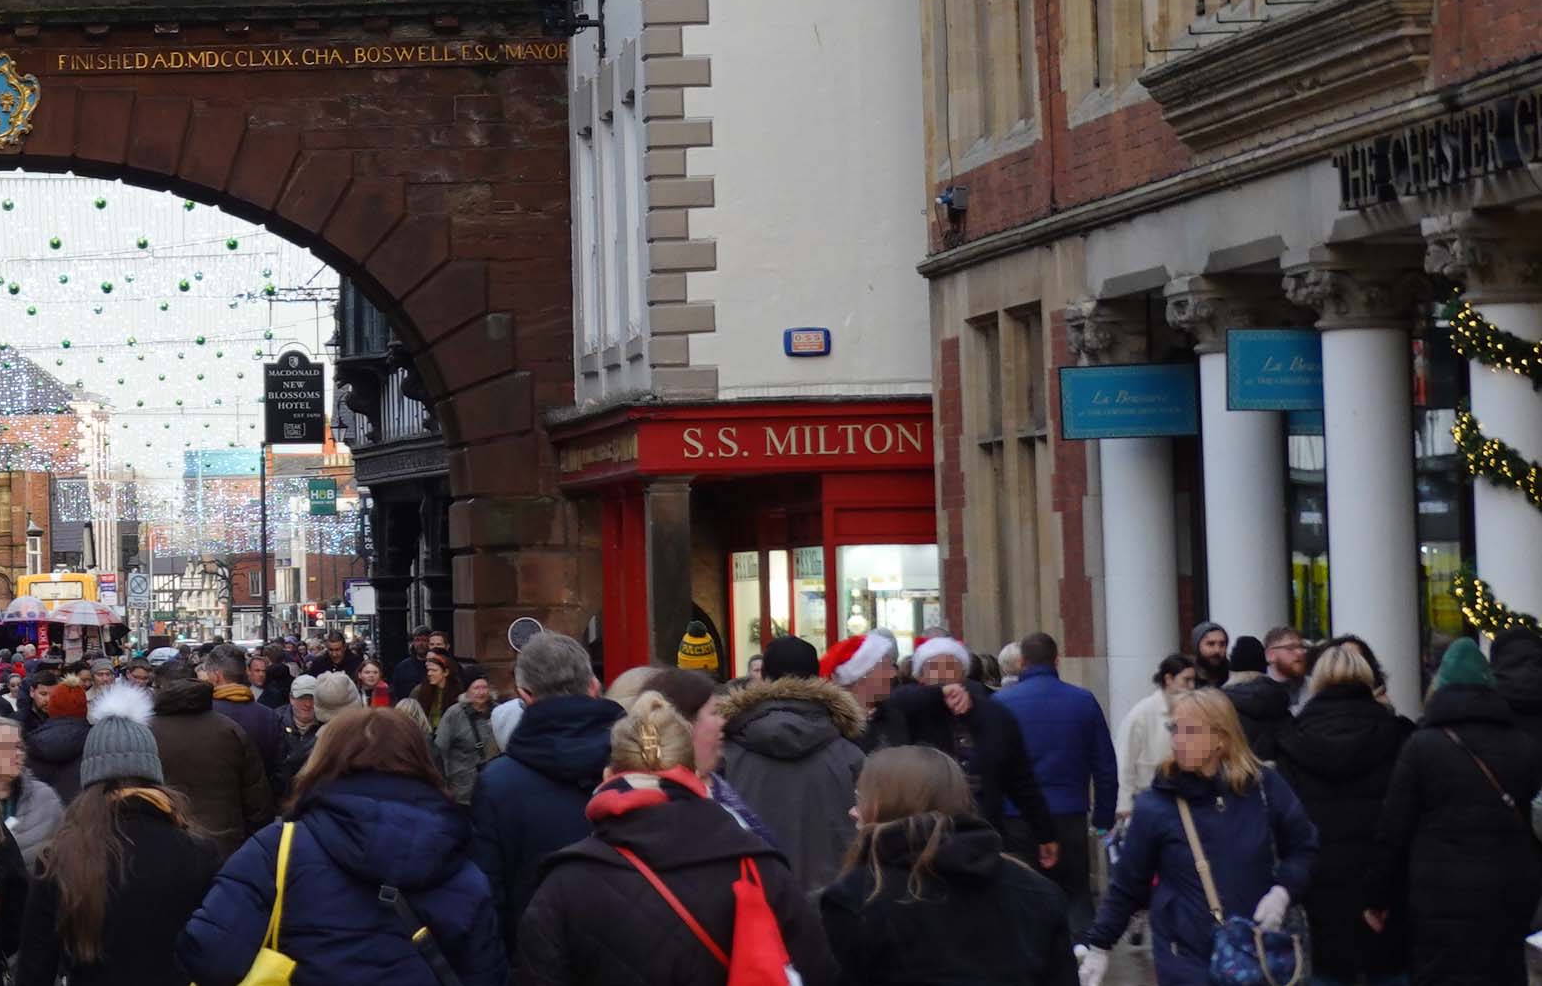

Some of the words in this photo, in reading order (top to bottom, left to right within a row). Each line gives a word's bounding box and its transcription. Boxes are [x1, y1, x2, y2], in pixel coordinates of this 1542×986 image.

[58, 52, 148, 70] FINISHED
[355, 44, 457, 64] BOSWELL
[1332, 141, 1380, 212] THE
[1388, 101, 1504, 196] CHESTER
[283, 381, 306, 389] NEW
[268, 391, 320, 400] BLOSSOMS
[278, 401, 311, 410] HOTEL
[683, 427, 749, 459] S.S.
[763, 422, 924, 456] MILTON
